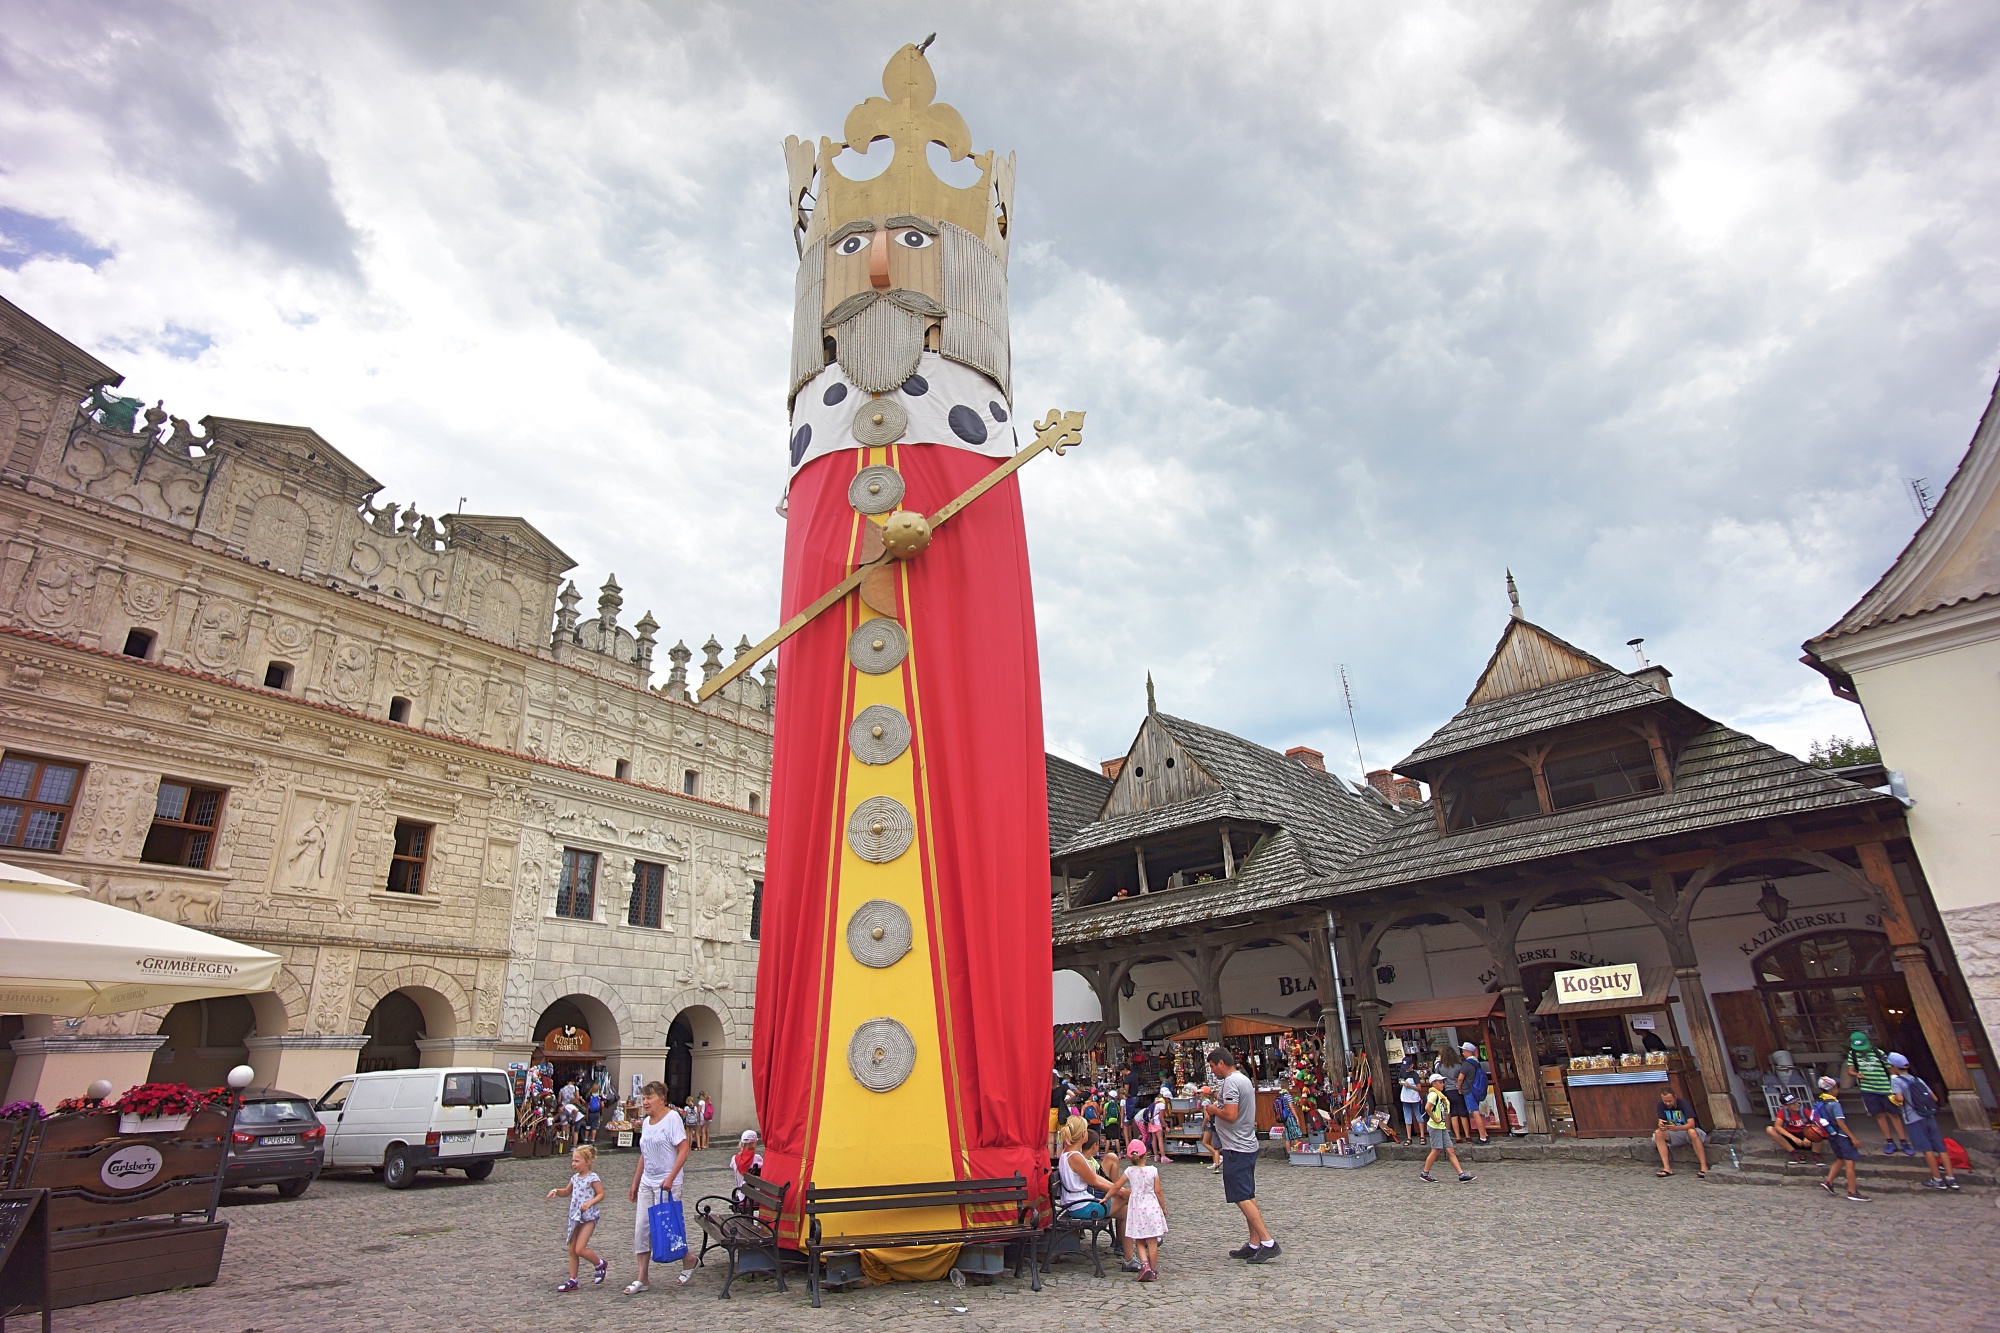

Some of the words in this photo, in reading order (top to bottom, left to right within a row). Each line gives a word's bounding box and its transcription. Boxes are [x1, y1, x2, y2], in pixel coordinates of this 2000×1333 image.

[1740, 912, 1847, 956] KAZIMIERSKI
[142, 957, 233, 974] GRIMBERGEN
[1478, 949, 1557, 985] KAIERSKI
[1570, 950, 1618, 966] SKŁA
[1278, 976, 1317, 996] BŁA
[1561, 972, 1632, 994] Koguty
[1146, 990, 1202, 1011] GALER
[553, 1033, 584, 1046] KOGUTY
[108, 1159, 156, 1177] Carlsberg
